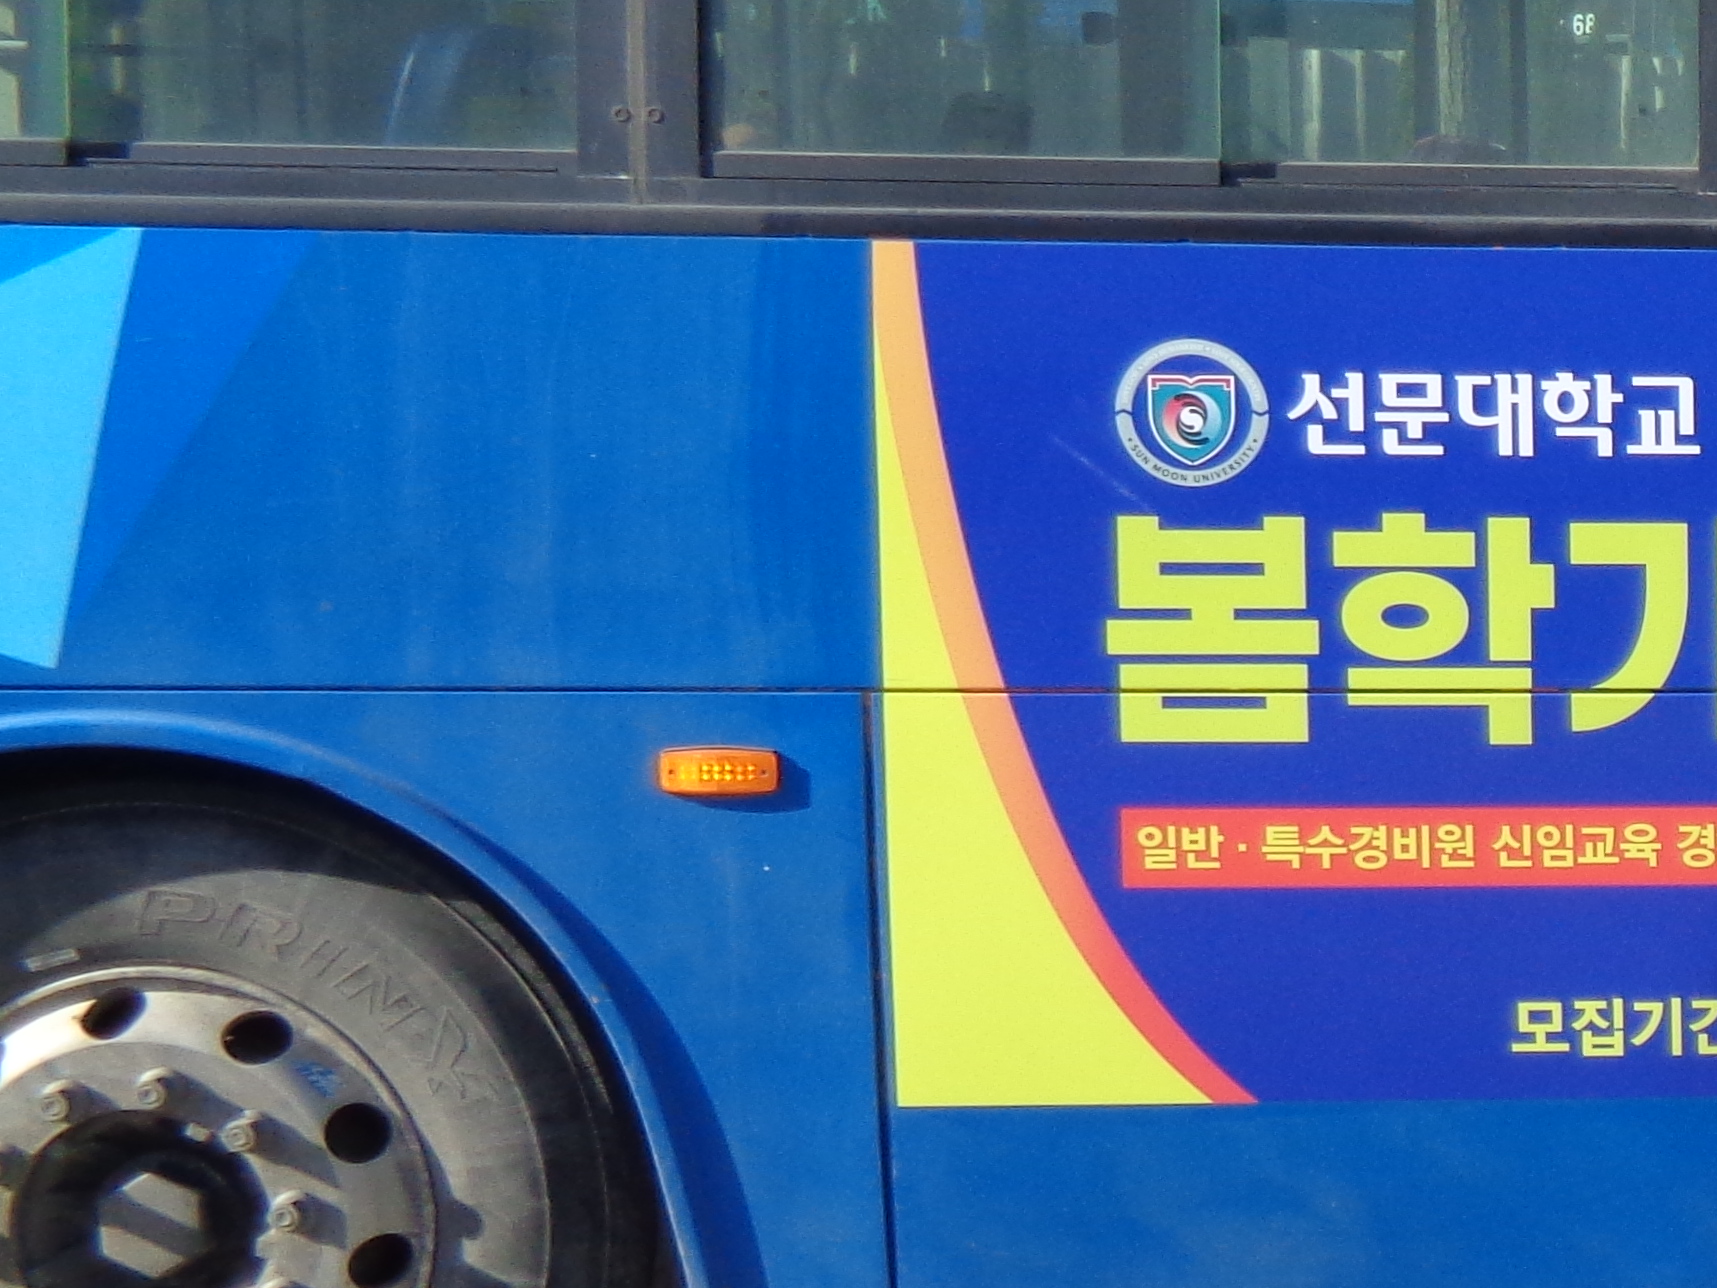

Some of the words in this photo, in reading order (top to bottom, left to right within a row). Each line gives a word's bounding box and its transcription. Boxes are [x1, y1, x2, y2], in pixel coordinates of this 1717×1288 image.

[1286, 371, 1701, 457] 선문대학교
[1129, 443, 1150, 465] SUN
[1152, 463, 1188, 483] MOON
[1193, 446, 1256, 483] UNIVERSITY
[1136, 824, 1225, 870] 일반
[1260, 823, 1475, 870] 특수경비원
[1491, 822, 1662, 868] 신임교육
